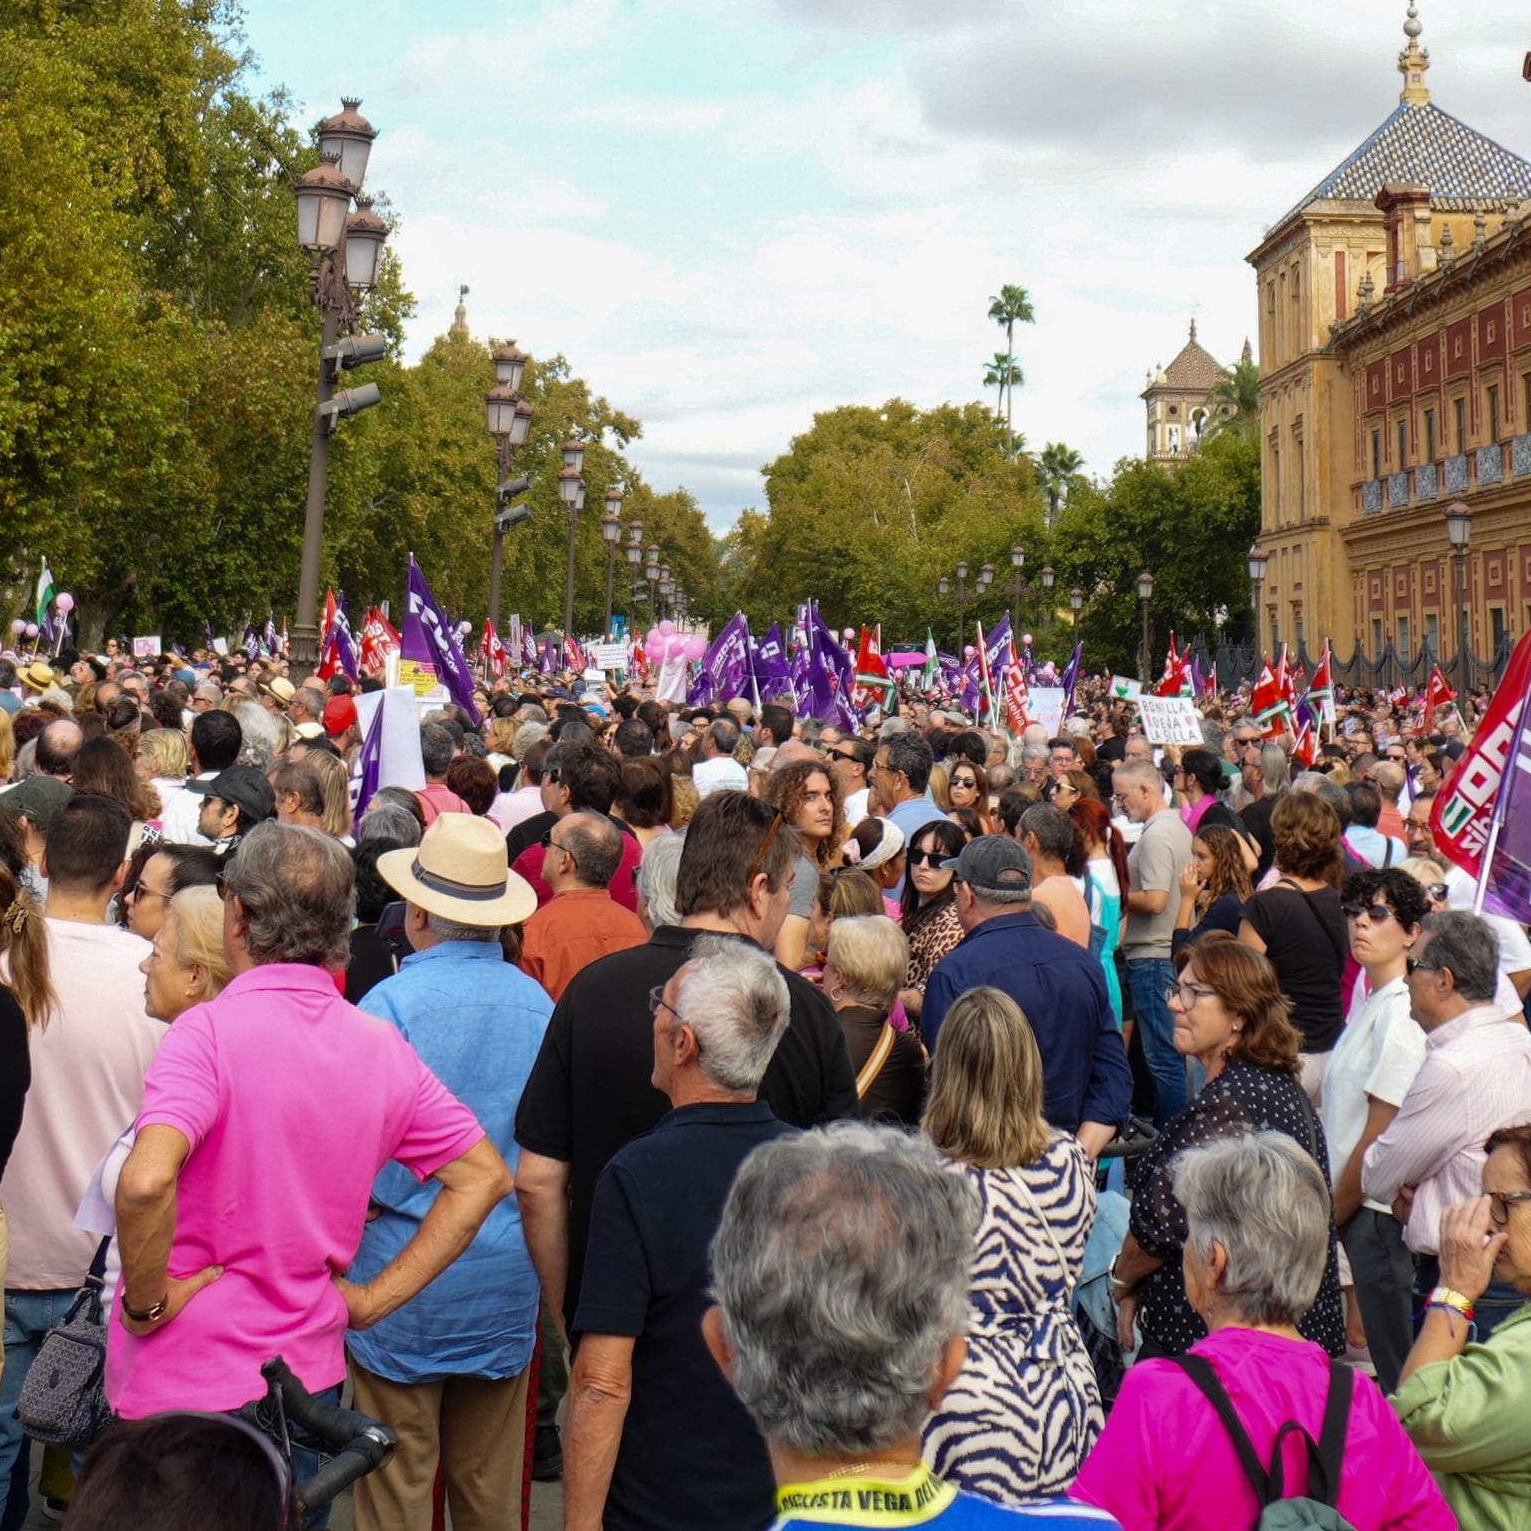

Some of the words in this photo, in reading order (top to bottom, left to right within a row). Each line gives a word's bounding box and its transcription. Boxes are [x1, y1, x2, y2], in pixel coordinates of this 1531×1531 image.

[1142, 700, 1188, 713] BONILLA
[1150, 729, 1161, 741] LA
[1163, 730, 1198, 742] SILLA
[857, 1490, 912, 1511] VEGA
[914, 1479, 935, 1508] DEL
